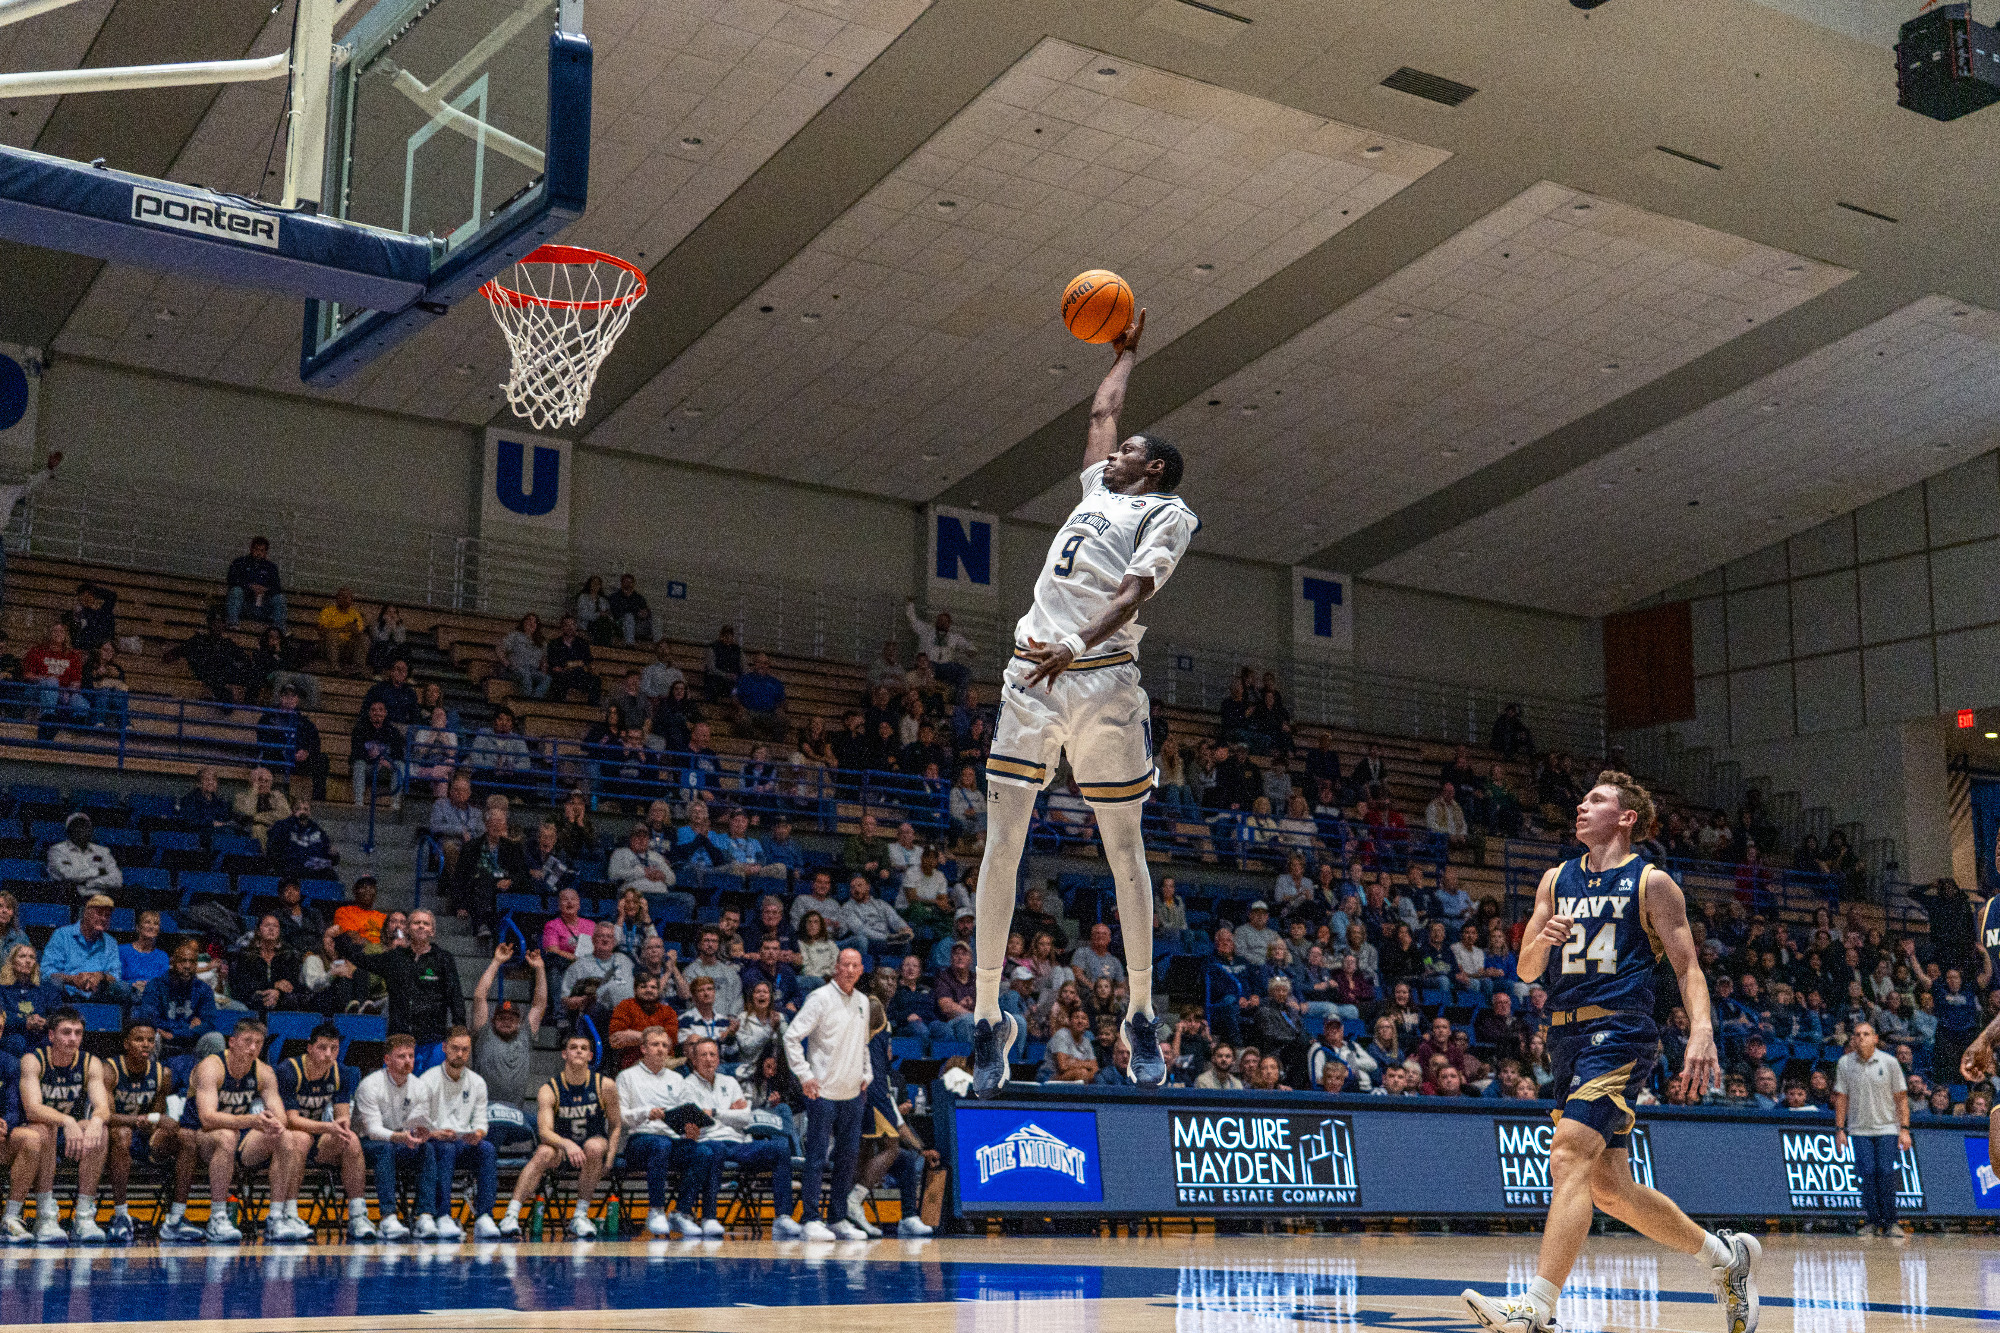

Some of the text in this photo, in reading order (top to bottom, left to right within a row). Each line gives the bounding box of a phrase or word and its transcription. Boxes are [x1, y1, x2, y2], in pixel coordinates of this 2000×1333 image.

[496, 440, 560, 516] U
[937, 514, 991, 586] N
[1053, 535, 1085, 578] 9
[1303, 576, 1342, 638] T
[1557, 896, 1631, 919] NAVY
[1561, 922, 1618, 975] 24
[41, 1083, 82, 1101] NAVY
[218, 1089, 256, 1106] NAVY
[558, 1102, 598, 1119] NAVY
[570, 1119, 588, 1141] 5
[1174, 1116, 1292, 1150] MAGUIRE
[1499, 1125, 1557, 1155] MAG
[976, 1140, 1086, 1184] THE MOUNT
[1175, 1151, 1296, 1184] HAYDEN
[1501, 1157, 1551, 1187] HAY
[1786, 1163, 1863, 1192] HAYDE
[1179, 1189, 1357, 1203] REAL ESTATE COMPANY
[1506, 1192, 1538, 1205] REAL
[1792, 1195, 1819, 1208] REAL
[1824, 1195, 1863, 1208] ESTATE
